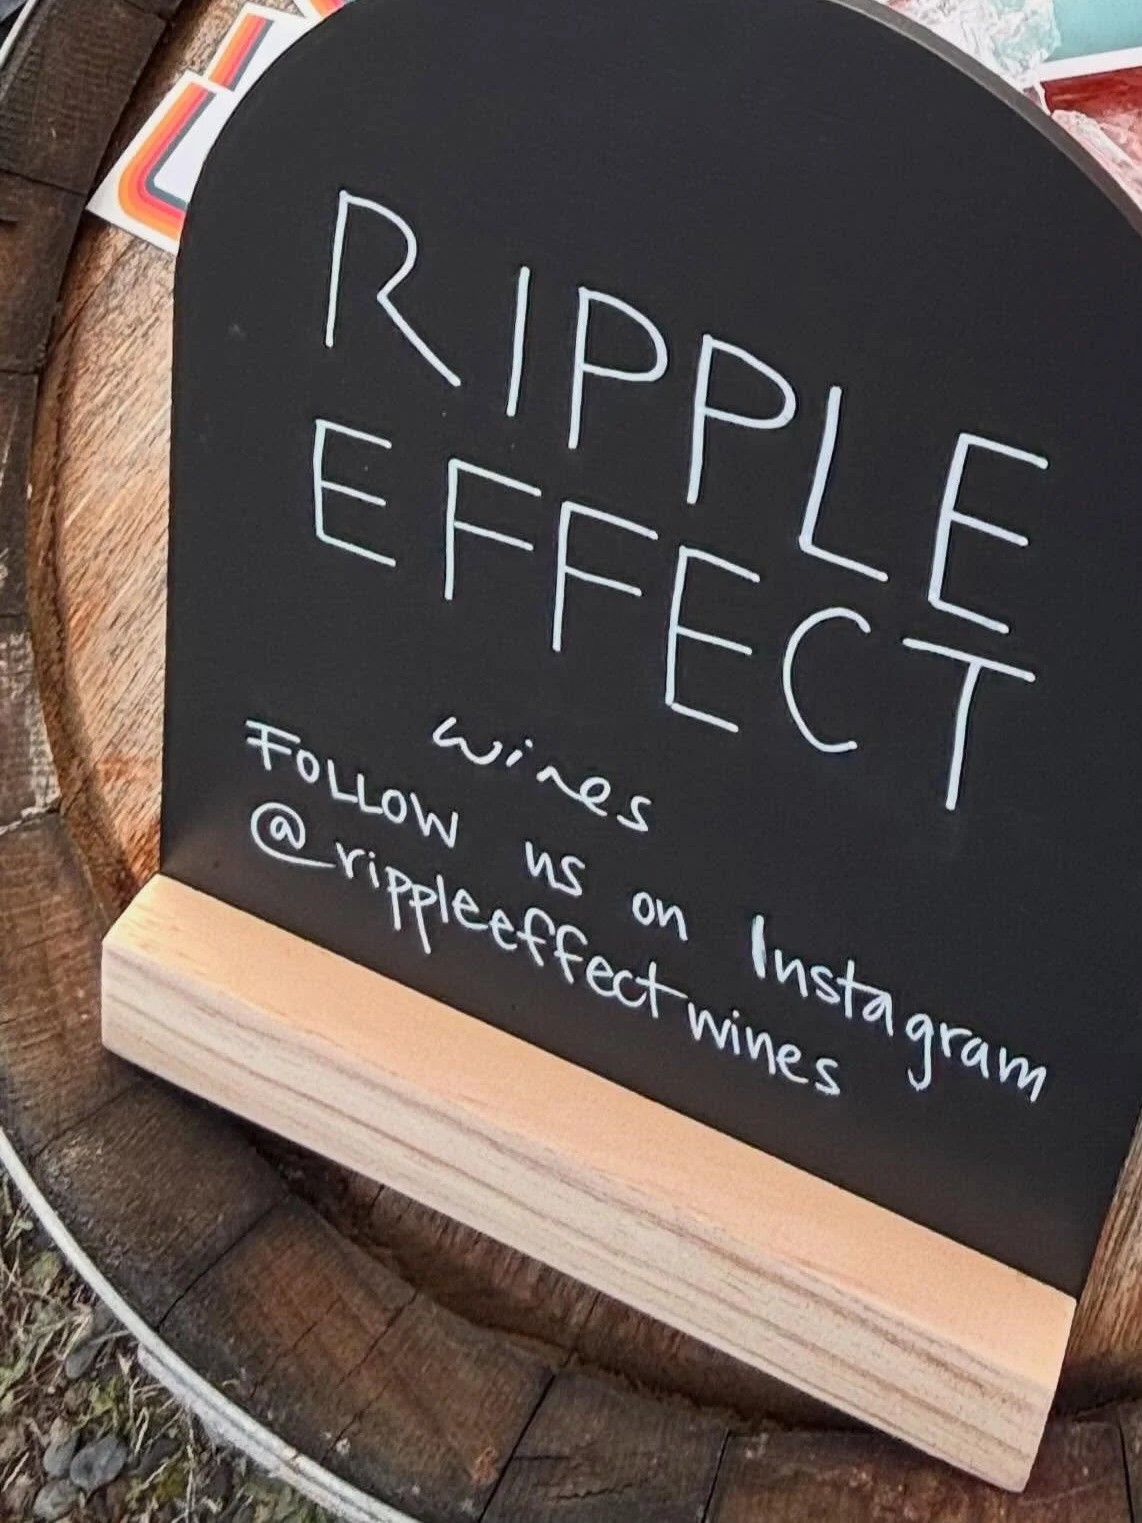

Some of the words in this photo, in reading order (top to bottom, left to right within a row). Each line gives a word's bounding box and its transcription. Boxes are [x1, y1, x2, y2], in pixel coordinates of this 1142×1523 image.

[323, 190, 1049, 636] RIPPLE
[314, 419, 1038, 811] EFFECT
[431, 716, 652, 834] wines
[525, 840, 587, 897] us
[632, 888, 690, 943] on
[750, 913, 1049, 1104] Instagram
